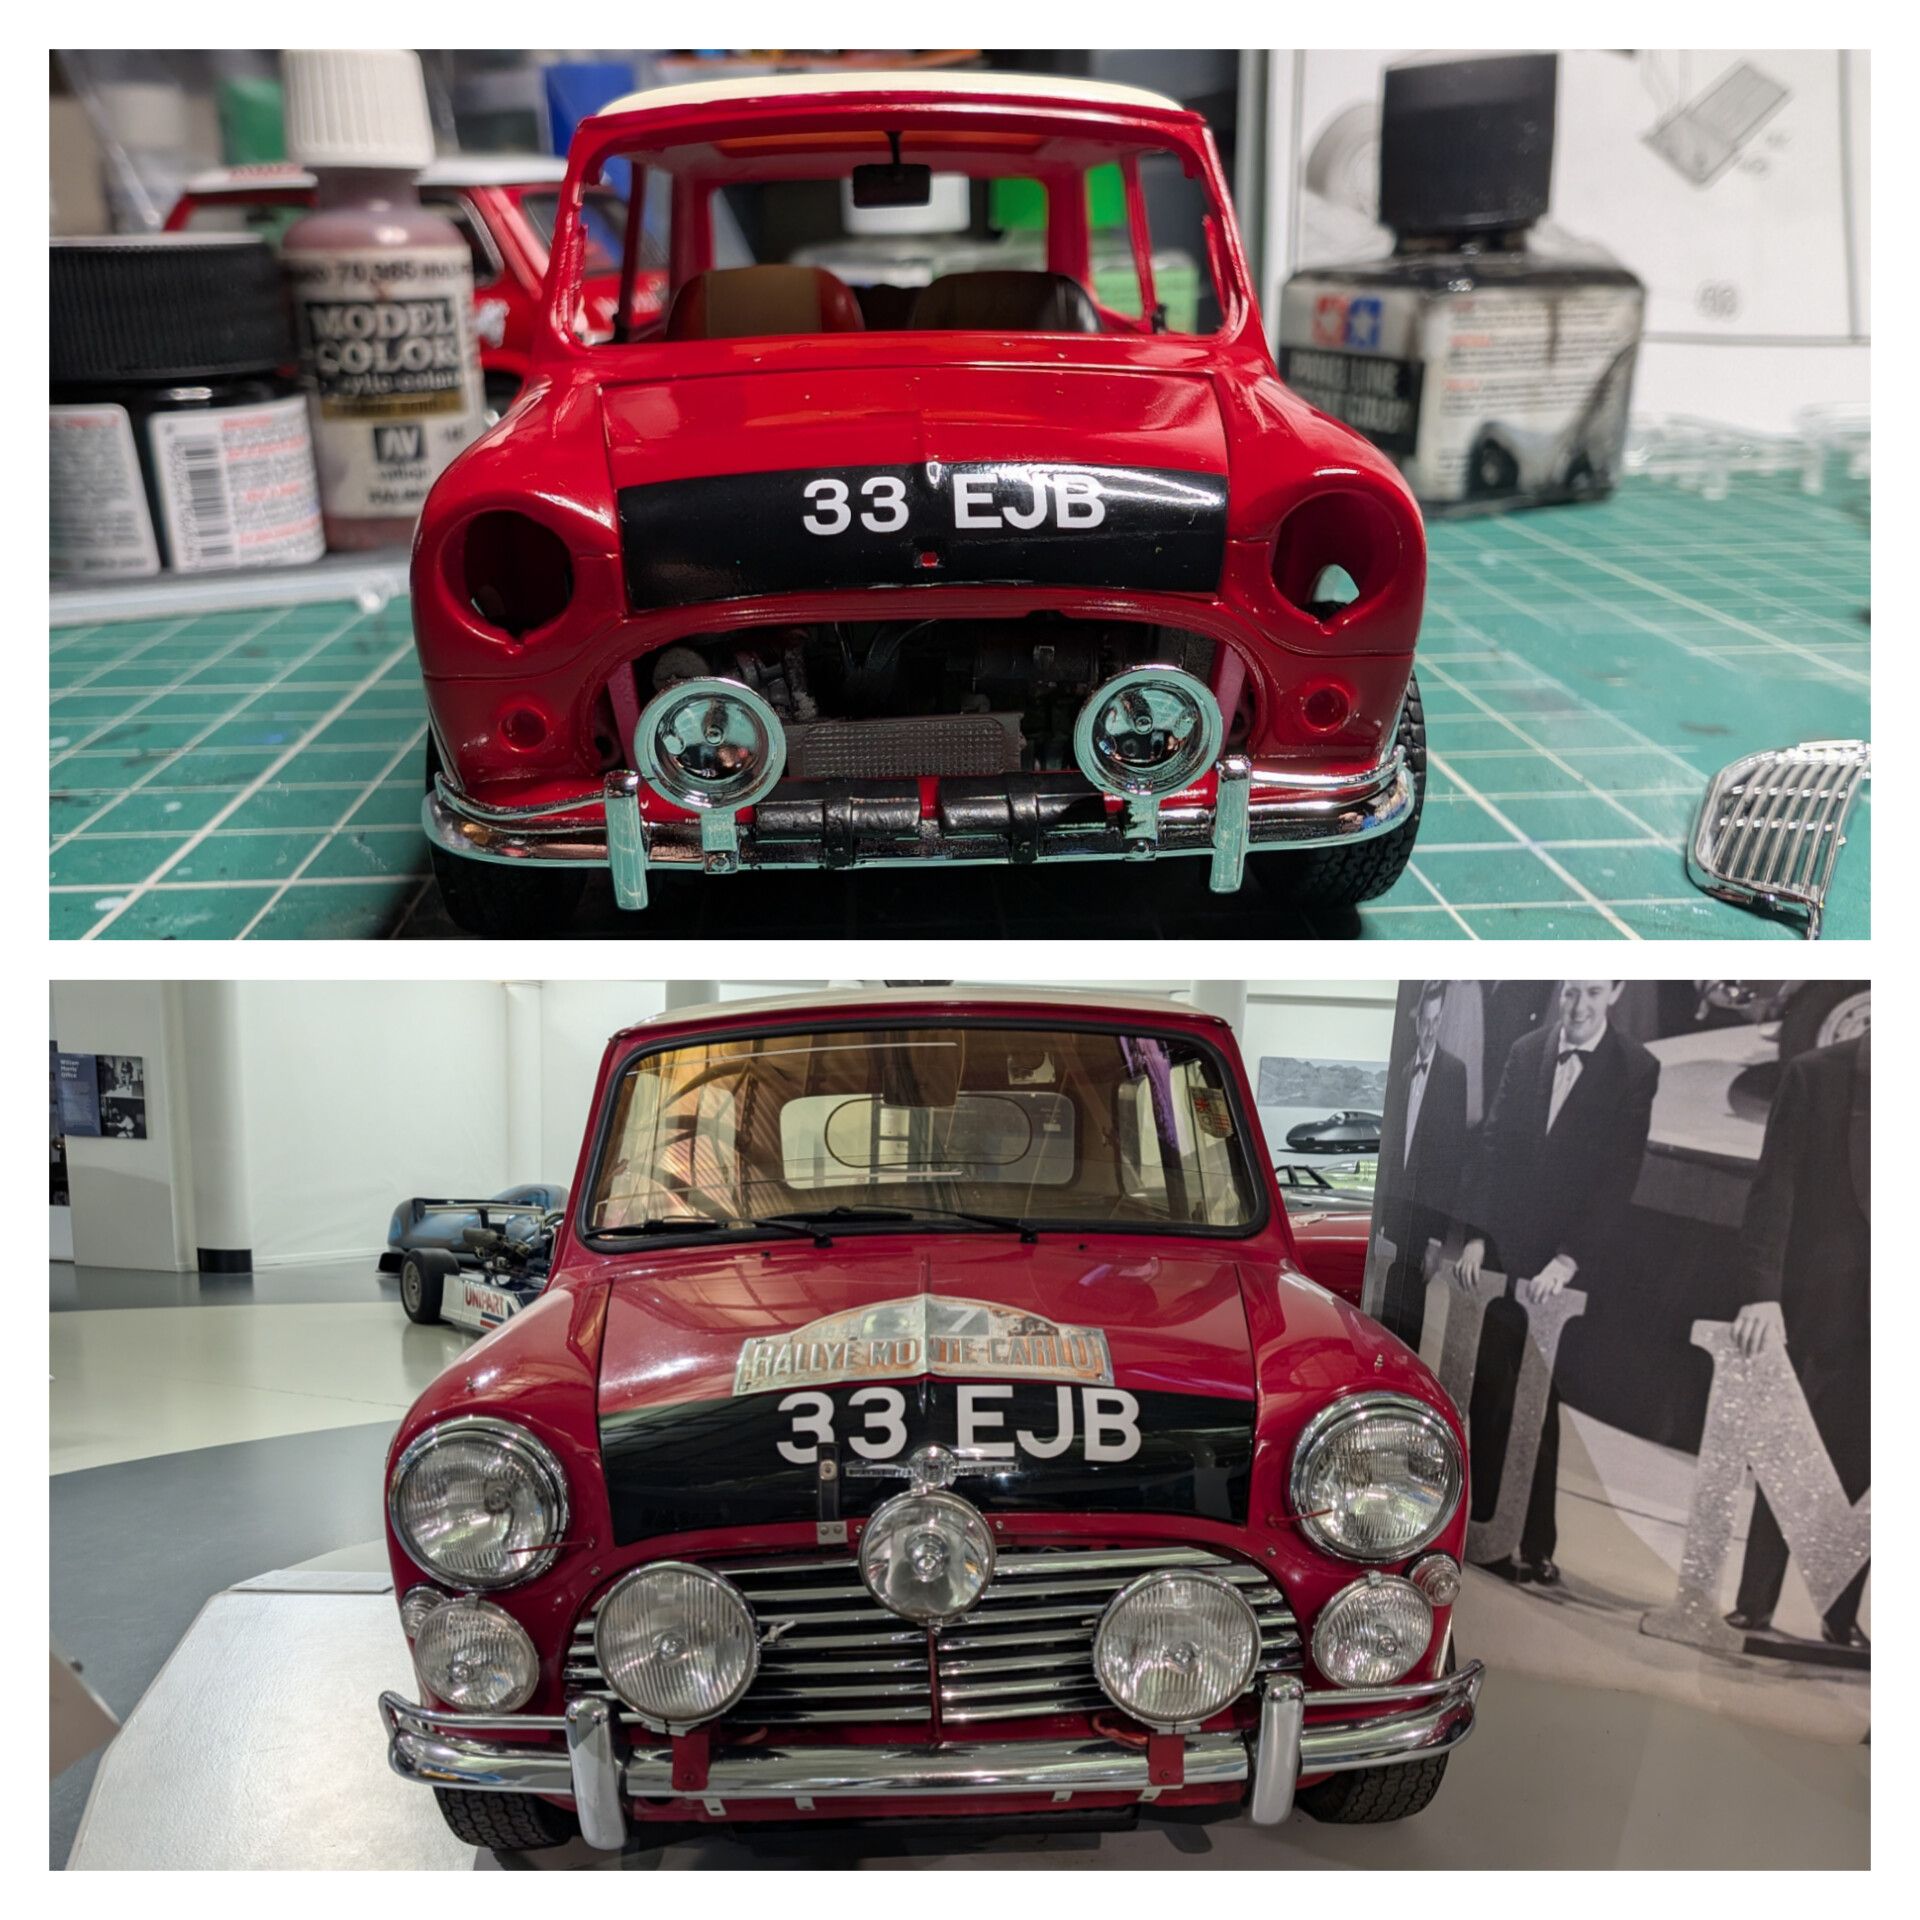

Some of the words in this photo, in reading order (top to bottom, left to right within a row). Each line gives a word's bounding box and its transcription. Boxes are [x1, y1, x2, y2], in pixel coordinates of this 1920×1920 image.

[311, 302, 457, 340] MODEL
[316, 337, 461, 376] COLOR
[803, 476, 909, 536] 33
[953, 472, 1106, 530] EJB
[465, 1286, 504, 1316] UNIPART
[776, 1387, 908, 1465] 33
[956, 1385, 1142, 1463] EJB
